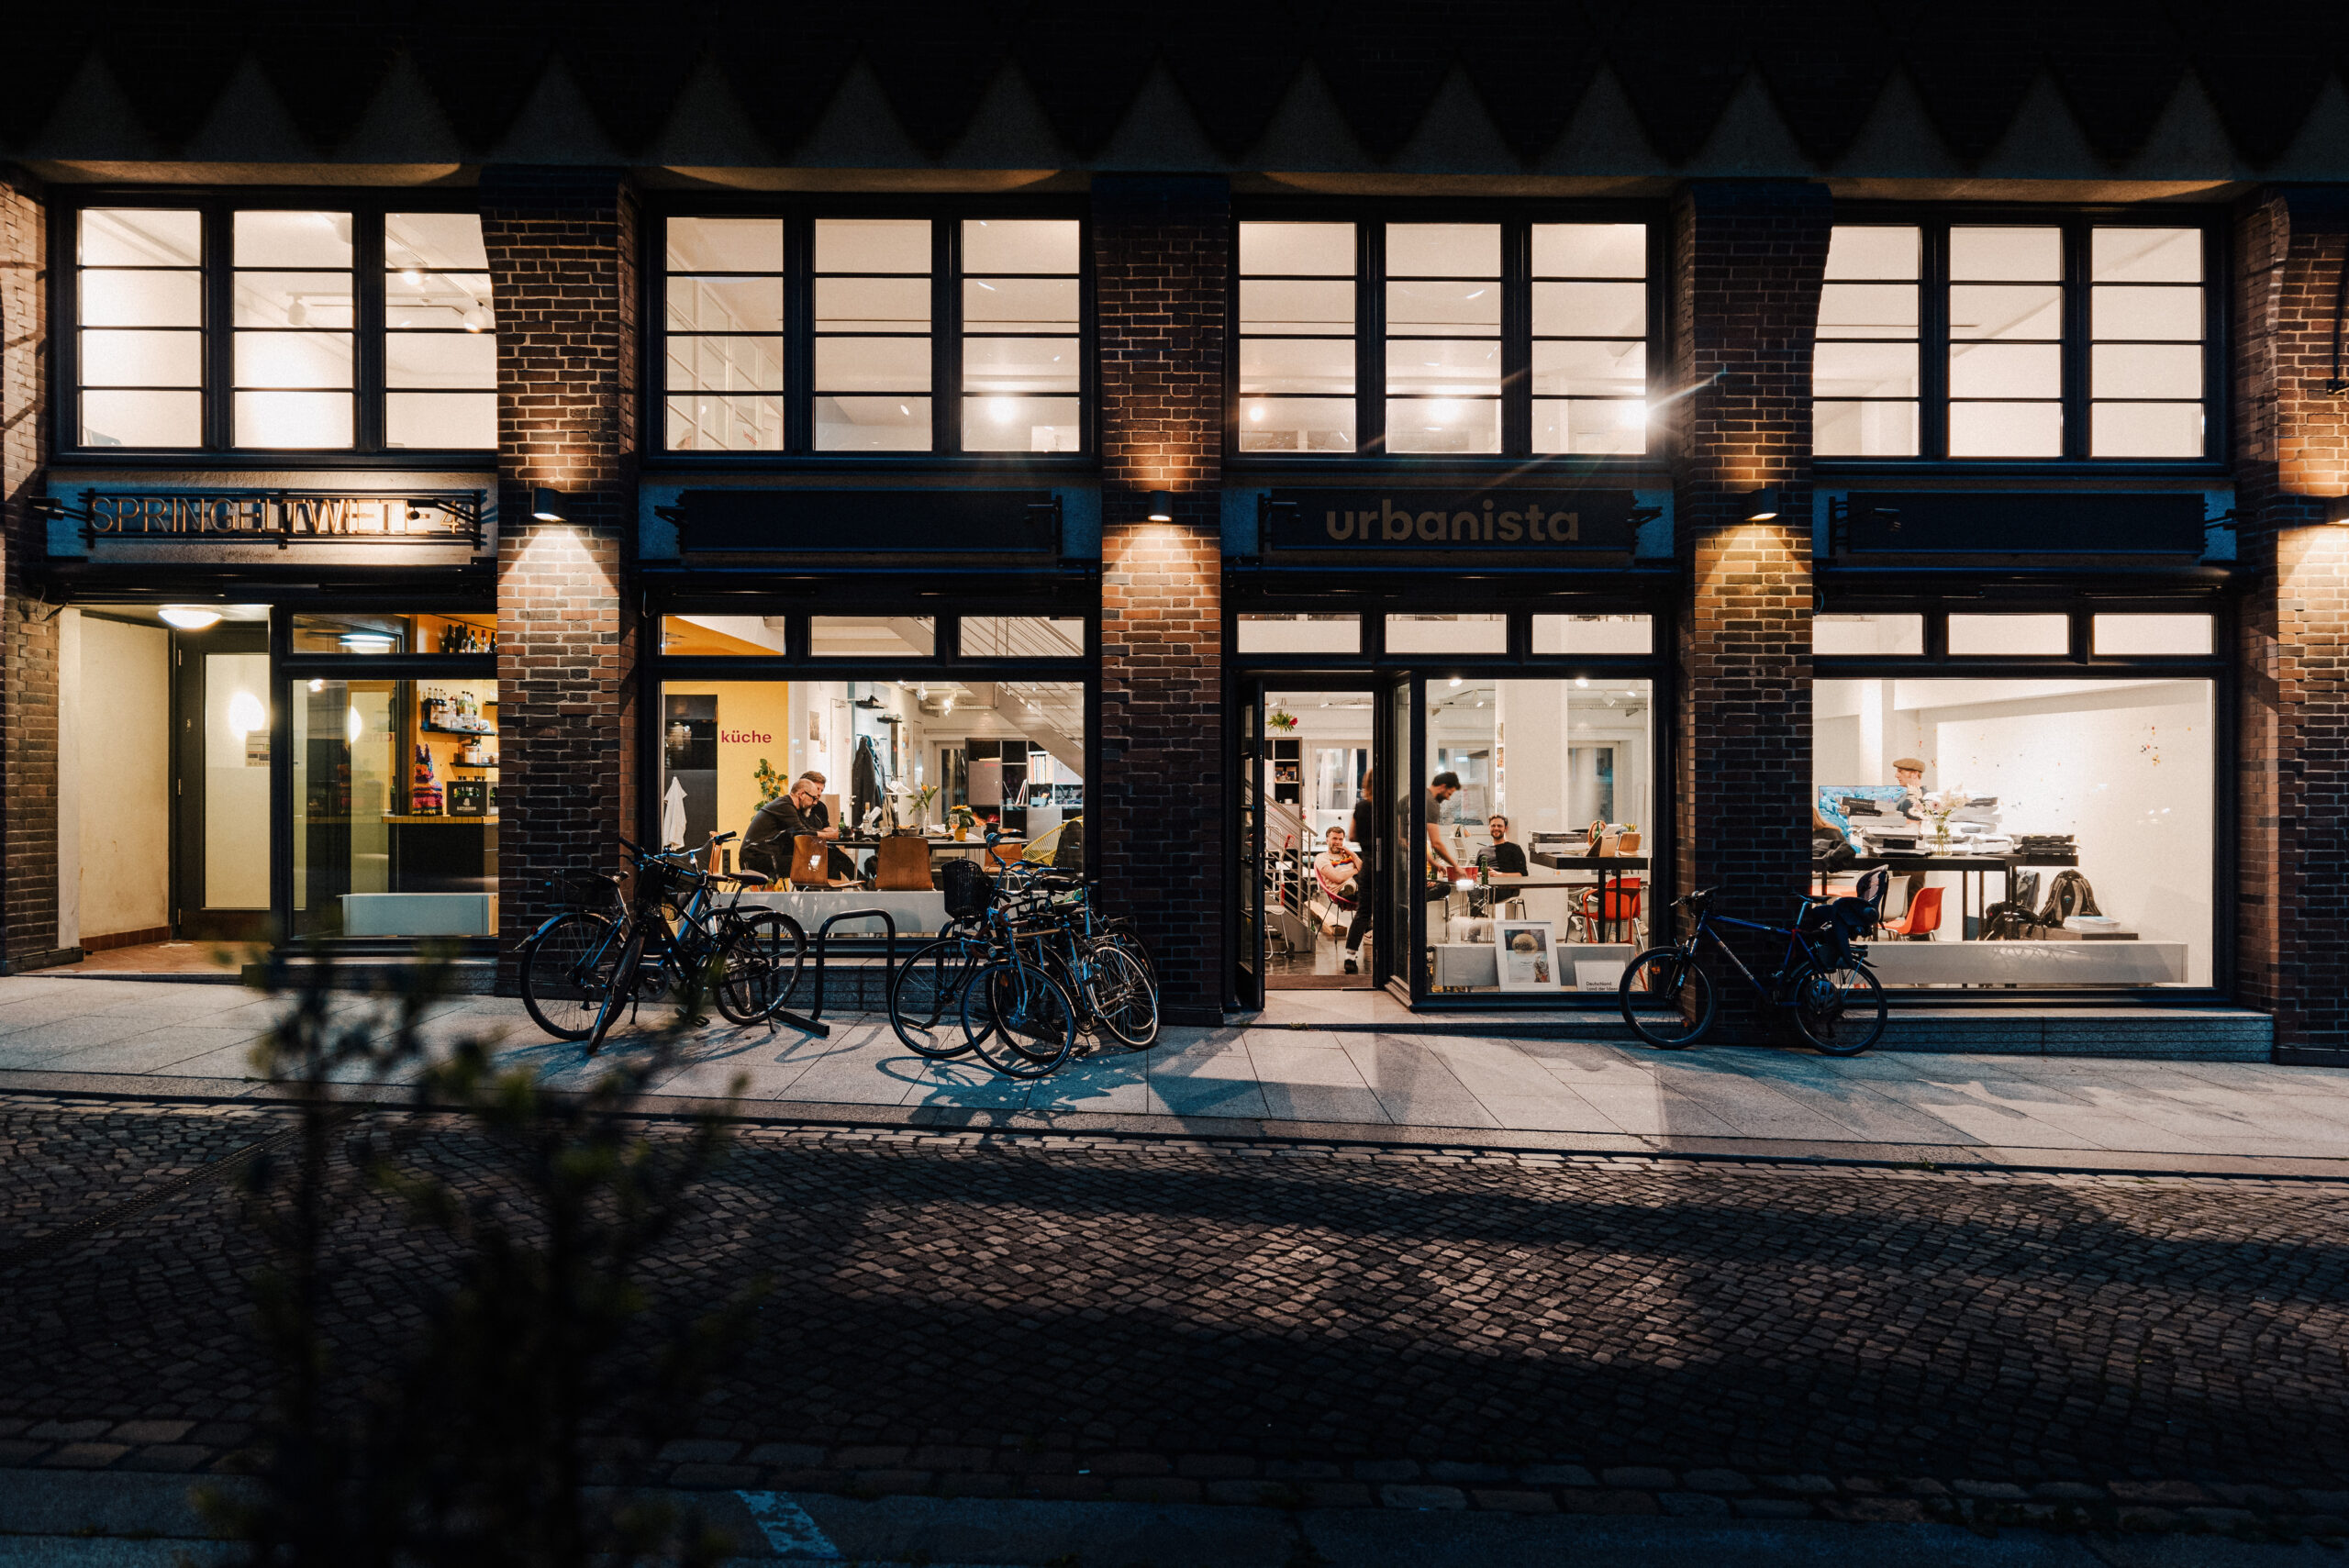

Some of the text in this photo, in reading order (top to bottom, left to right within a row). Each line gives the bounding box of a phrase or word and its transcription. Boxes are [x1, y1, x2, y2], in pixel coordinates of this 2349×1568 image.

[440, 499, 461, 534] 4
[1326, 498, 1579, 541] urbanista
[720, 729, 772, 743] küche
